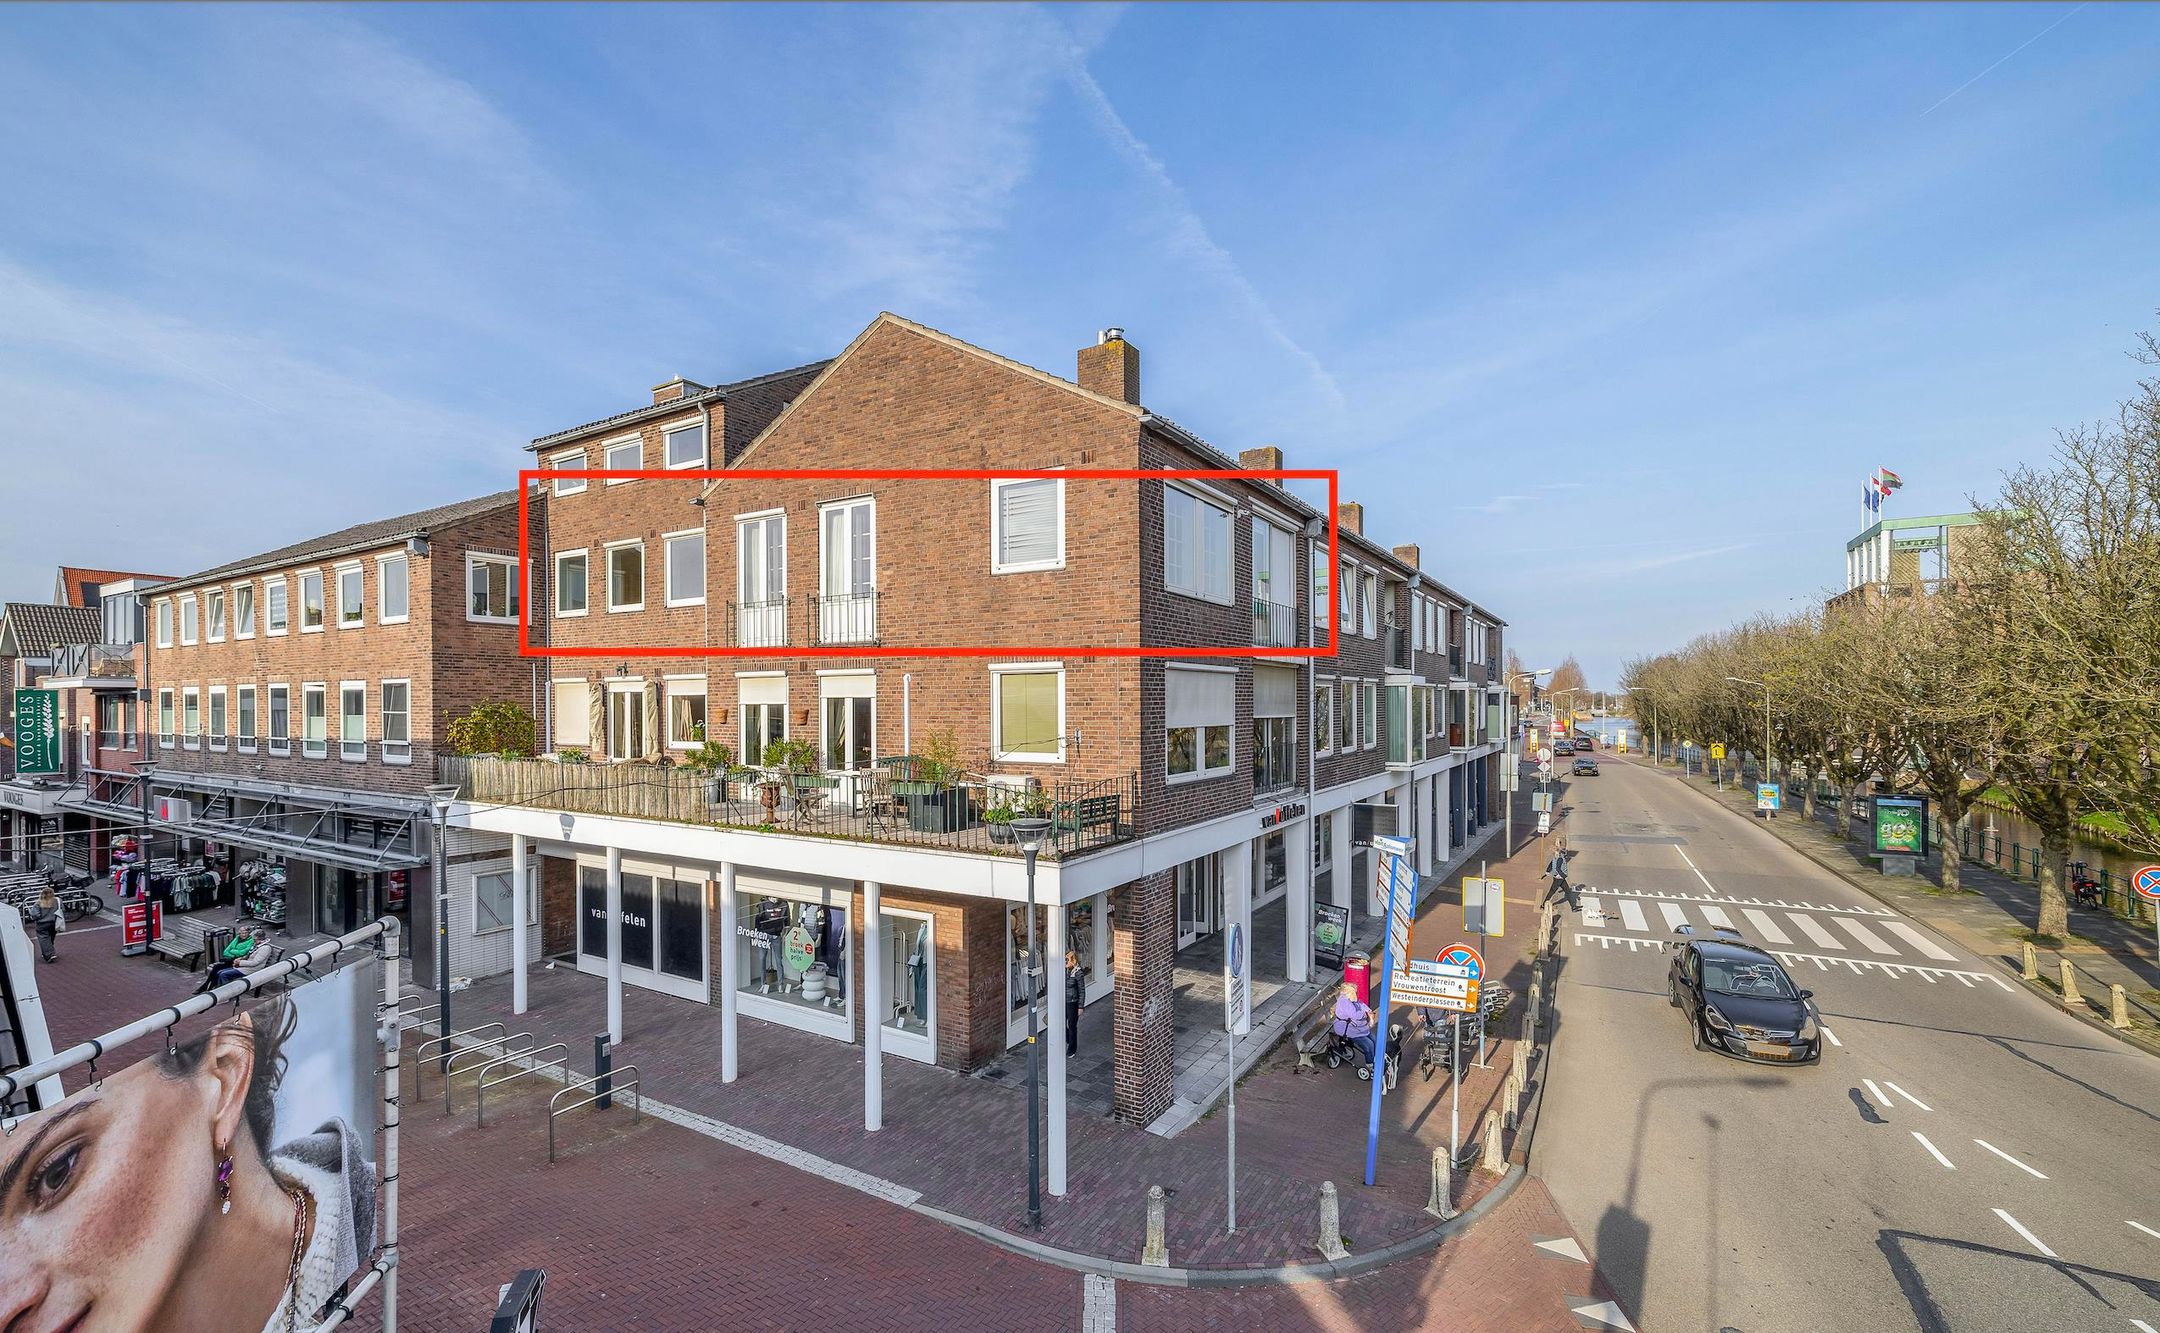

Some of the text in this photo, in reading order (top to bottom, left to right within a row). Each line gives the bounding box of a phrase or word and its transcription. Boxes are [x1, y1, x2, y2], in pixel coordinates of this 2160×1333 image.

[20, 696, 35, 769] VOOGES
[591, 908, 646, 927] van felen
[737, 926, 768, 940] Broeken
[751, 938, 772, 950] week
[1393, 972, 1456, 987] Recreatieterrein
[1393, 980, 1447, 994] Vrouwentroost
[1391, 992, 1455, 1007] Westeinderplassen
